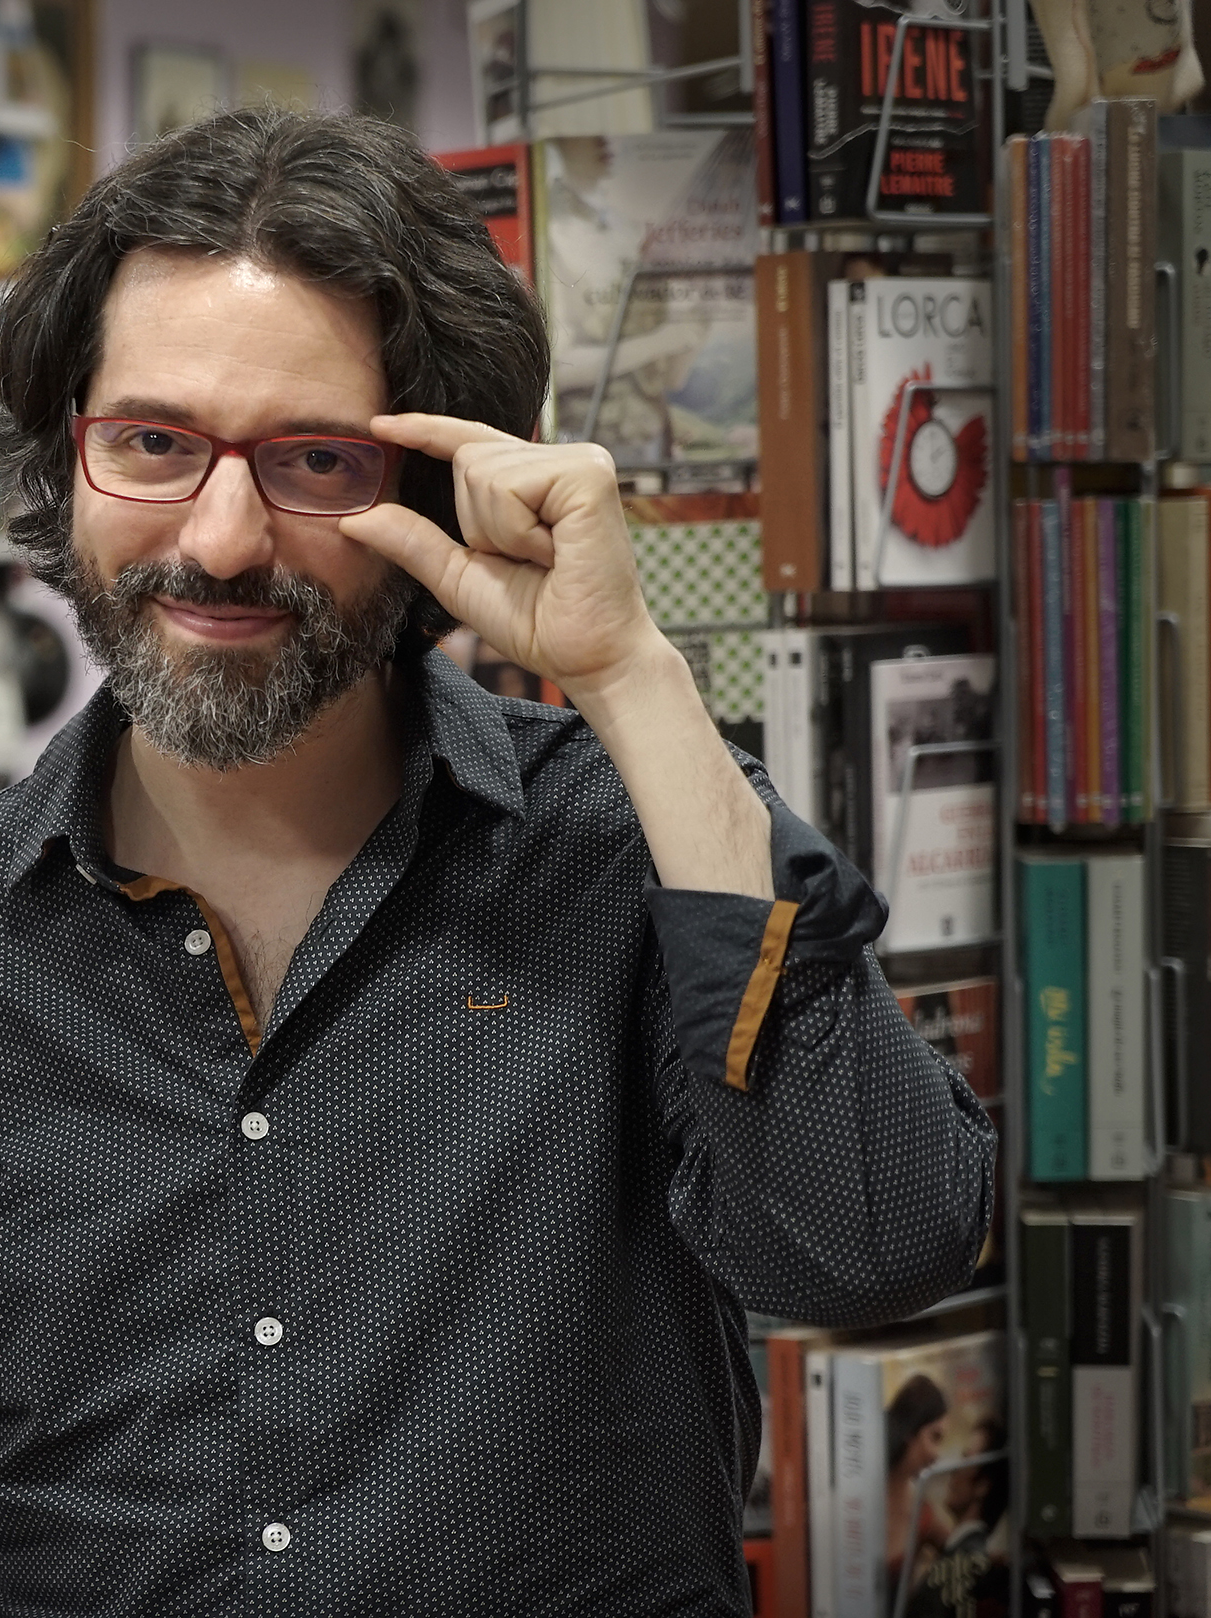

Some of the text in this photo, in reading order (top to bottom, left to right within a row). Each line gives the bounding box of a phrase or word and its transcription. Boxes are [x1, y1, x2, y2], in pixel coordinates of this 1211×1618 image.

[811, 3, 837, 63] IRENE
[860, 21, 968, 102] IRENE
[890, 150, 946, 173] PIERRE
[880, 174, 954, 197] LEMAITRE
[877, 292, 986, 338] LORCA
